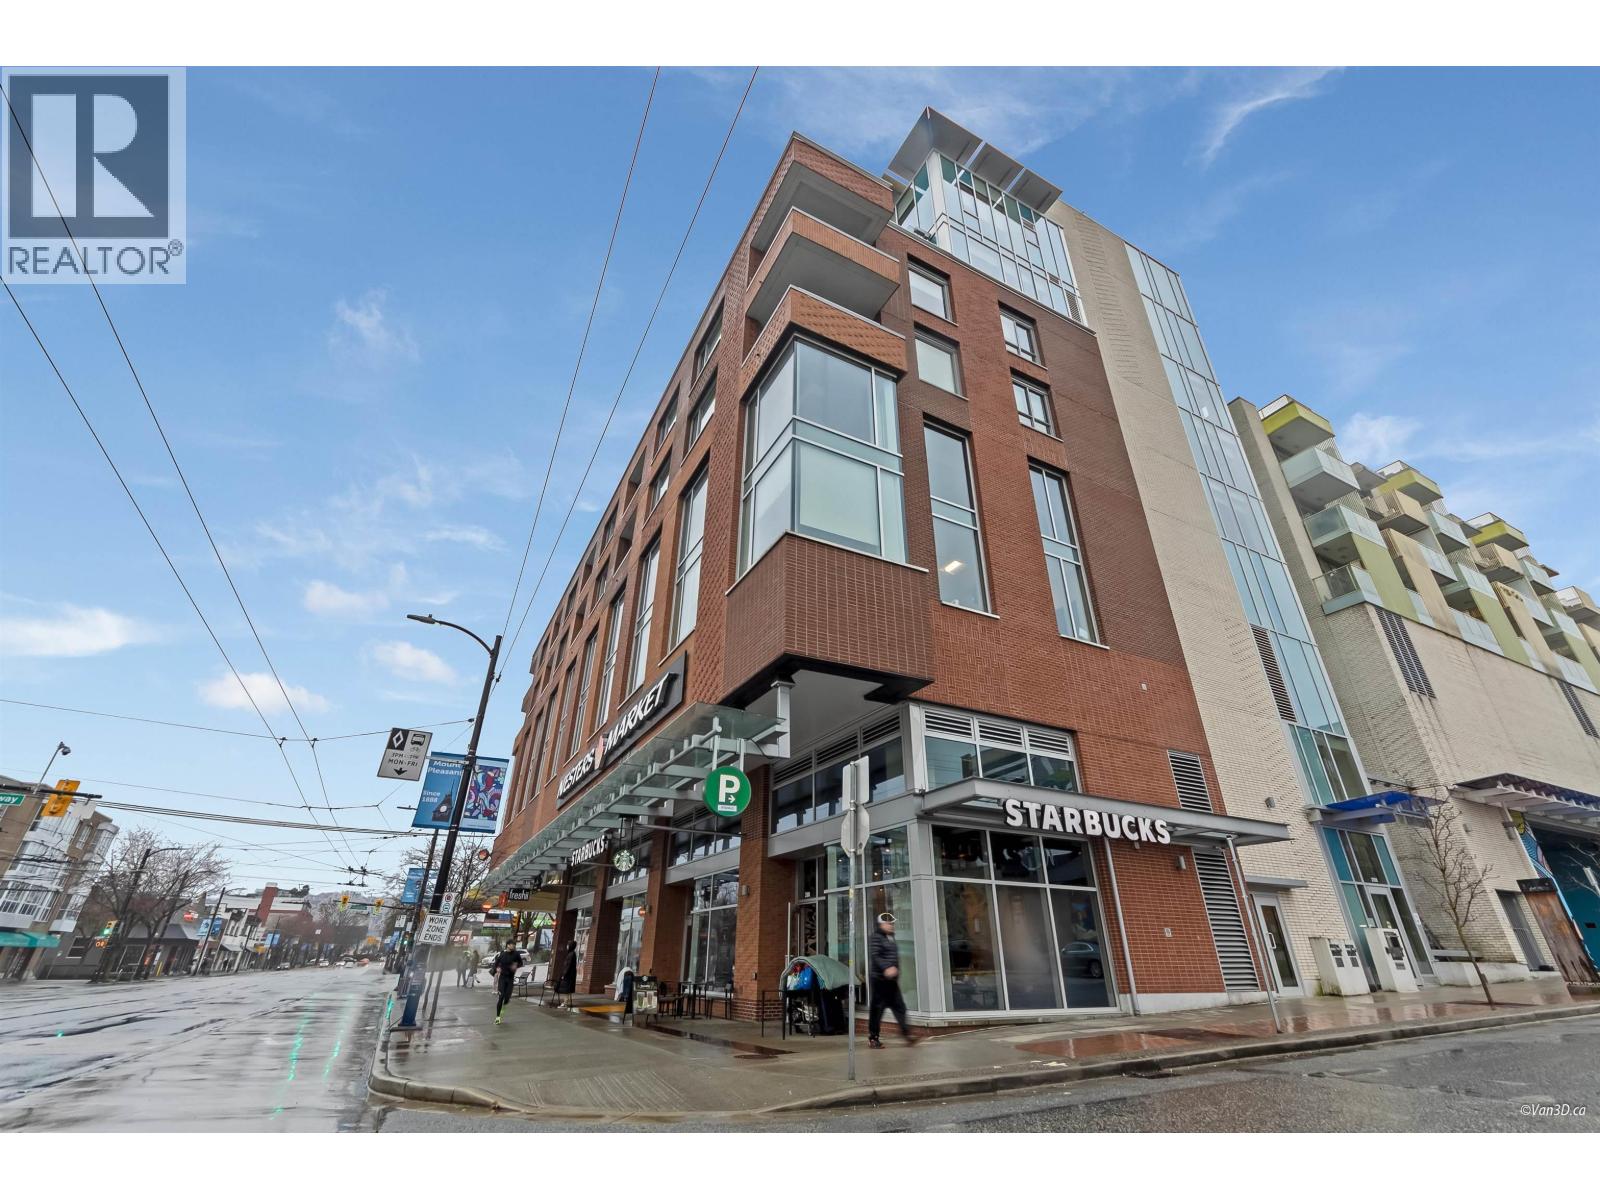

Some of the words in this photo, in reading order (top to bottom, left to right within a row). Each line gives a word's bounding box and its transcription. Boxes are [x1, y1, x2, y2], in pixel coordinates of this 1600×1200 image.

[557, 748, 595, 799] NESTERS
[604, 672, 674, 755] MARKET
[719, 774, 740, 803] P
[1005, 799, 1171, 845] STARBUCKS
[571, 834, 605, 867] STARBUCKS
[426, 925, 446, 933] ZONE
[429, 917, 448, 925] WORK
[423, 933, 442, 941] ENDS
